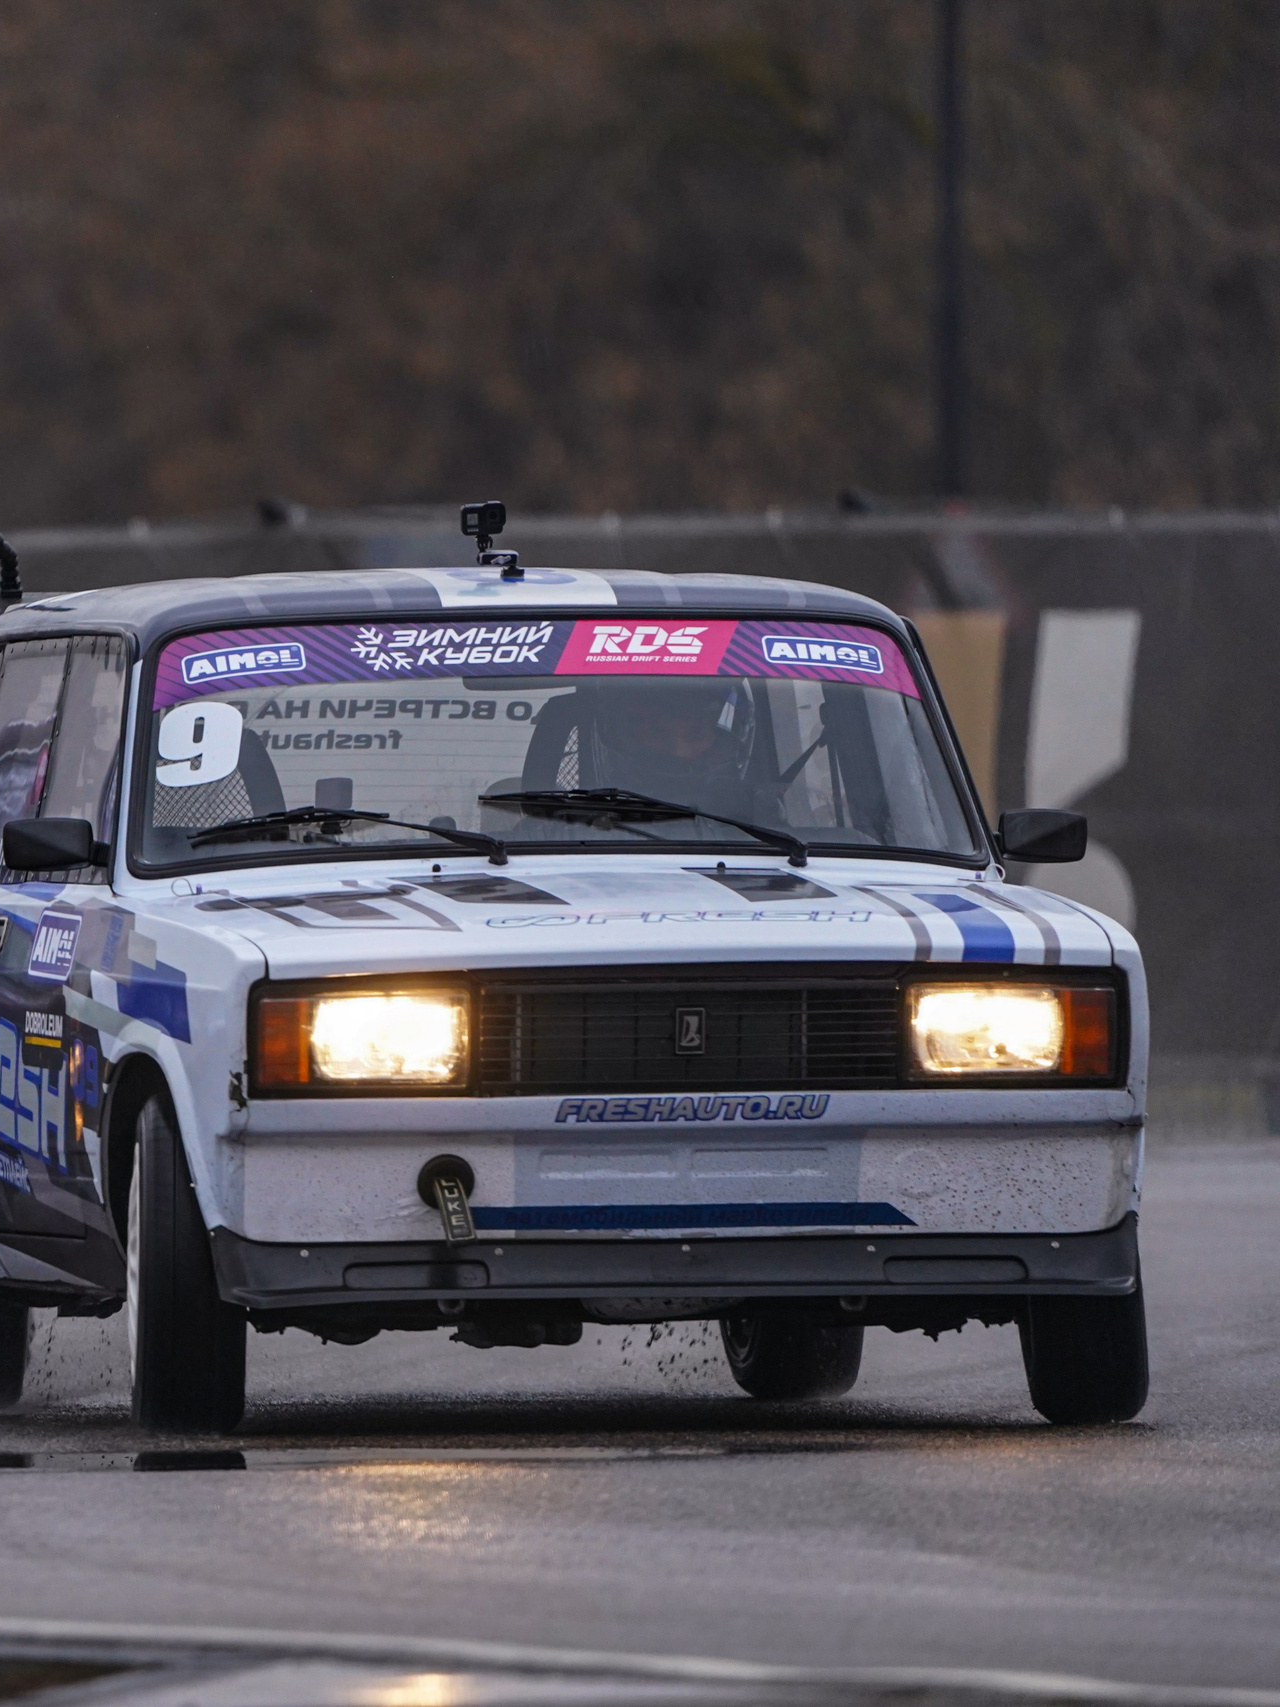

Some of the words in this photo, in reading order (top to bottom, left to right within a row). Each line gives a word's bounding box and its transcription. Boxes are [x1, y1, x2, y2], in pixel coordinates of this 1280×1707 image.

[389, 621, 554, 648] ЗИМНИЙ
[590, 625, 709, 654] RDS
[189, 648, 300, 678] AIMOL
[418, 645, 546, 667] КУБОК
[586, 655, 629, 663] RUSSIAN
[631, 655, 661, 663] DRIFT
[770, 642, 878, 668] AIMOL
[156, 701, 244, 788] 9
[24, 1011, 63, 1037] DOBROLEUM
[555, 1094, 830, 1123] FRESHAUTO.RU
